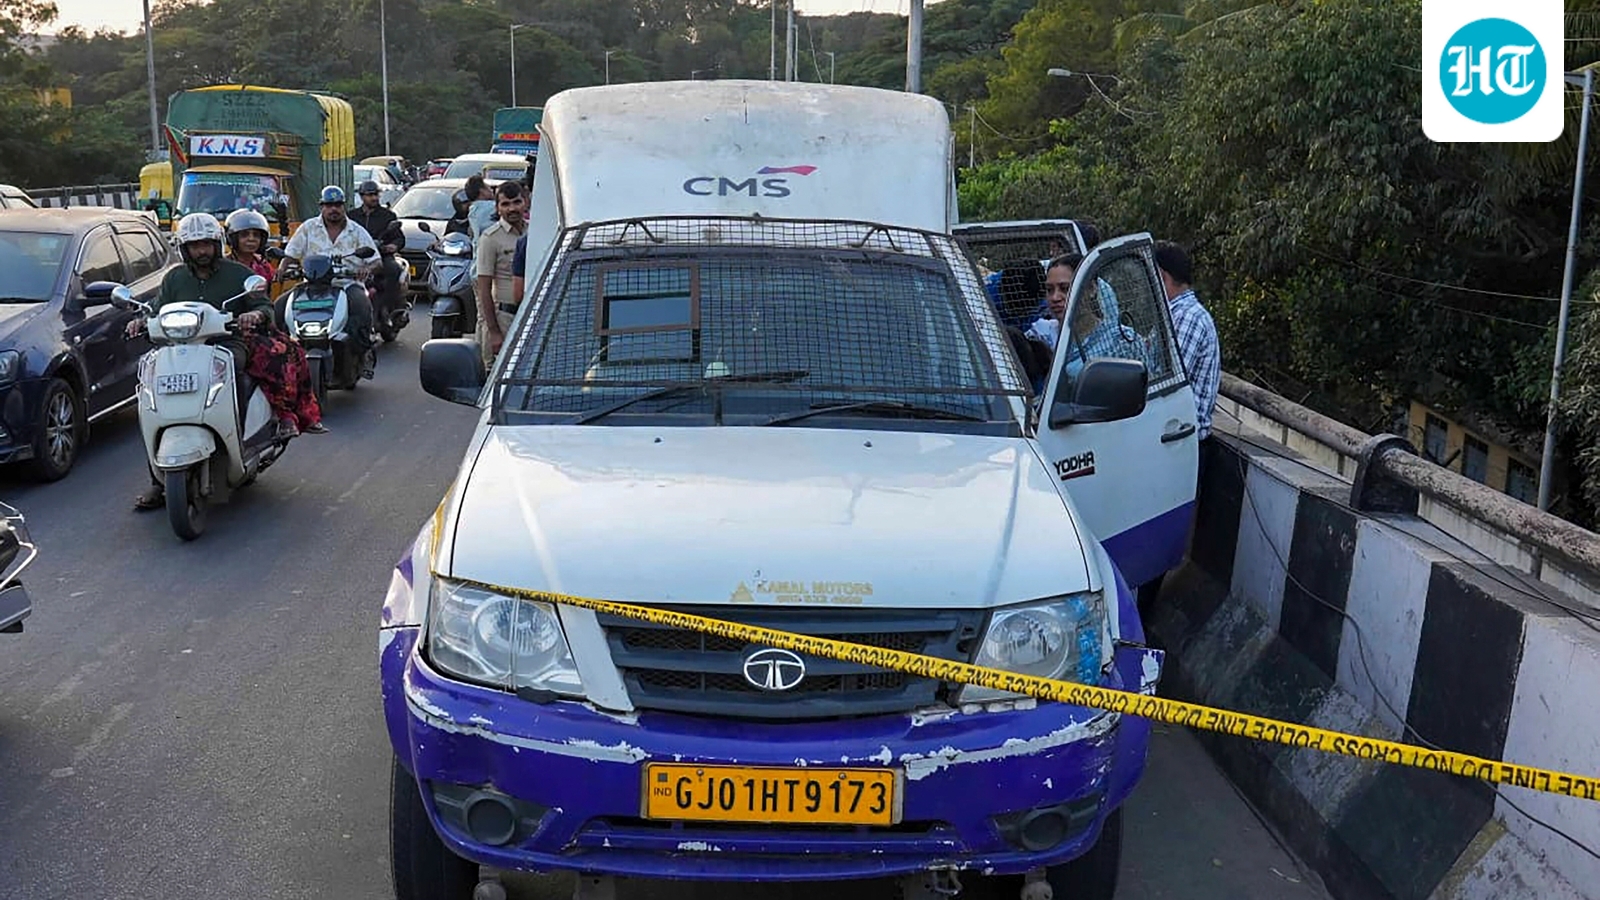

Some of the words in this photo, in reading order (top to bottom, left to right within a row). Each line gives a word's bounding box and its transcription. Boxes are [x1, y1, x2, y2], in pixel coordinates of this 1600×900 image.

[197, 138, 258, 155] K.N.S
[683, 176, 791, 198] CMS
[1053, 450, 1095, 476] YODHA
[1001, 675, 1064, 702] POLICE
[1068, 687, 1129, 713] CROSS
[1133, 697, 1170, 721] NOT
[1173, 705, 1202, 727] DO
[1204, 712, 1248, 737] LINE
[1253, 721, 1324, 750] POLICE
[1333, 737, 1402, 766] CROSS
[1412, 752, 1454, 775] NOT
[1460, 760, 1493, 783] DO
[1501, 766, 1550, 793] LINE
[654, 787, 672, 797] IND
[675, 776, 887, 814] GJ01HT9173
[1558, 776, 1600, 800] ICE
